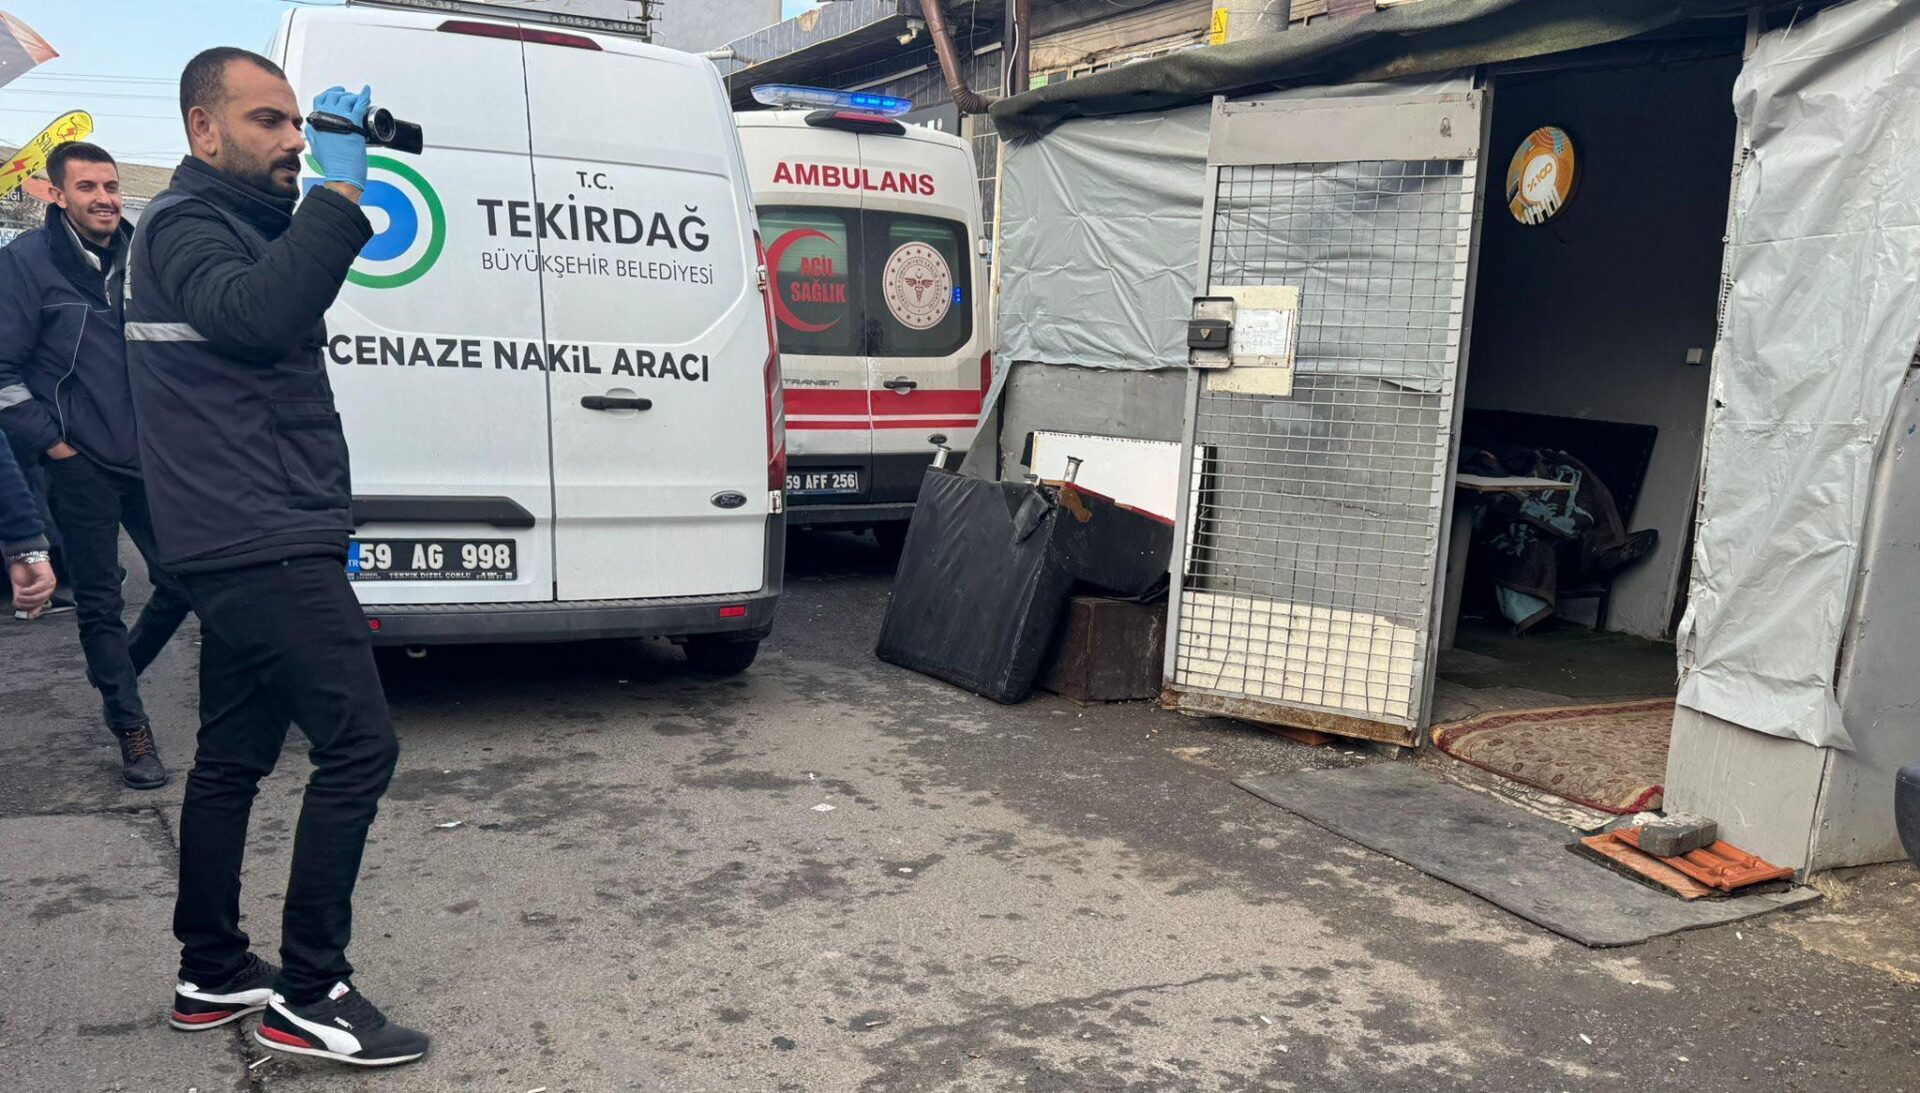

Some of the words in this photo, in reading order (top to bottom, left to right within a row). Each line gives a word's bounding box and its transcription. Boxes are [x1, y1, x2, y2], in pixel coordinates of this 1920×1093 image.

[576, 172, 614, 190] T.C.
[773, 162, 935, 196] AMBULANS
[477, 194, 710, 252] TEKİRDAĞ
[482, 251, 609, 278] BÜYÜKŞEHİR
[328, 335, 482, 369] CENAZE
[612, 348, 709, 382] ARACI
[786, 475, 801, 490] 59
[805, 475, 828, 490] AFF
[832, 474, 855, 488] 256
[359, 544, 392, 569] 59
[412, 544, 444, 569] AG
[461, 544, 510, 569] 998
